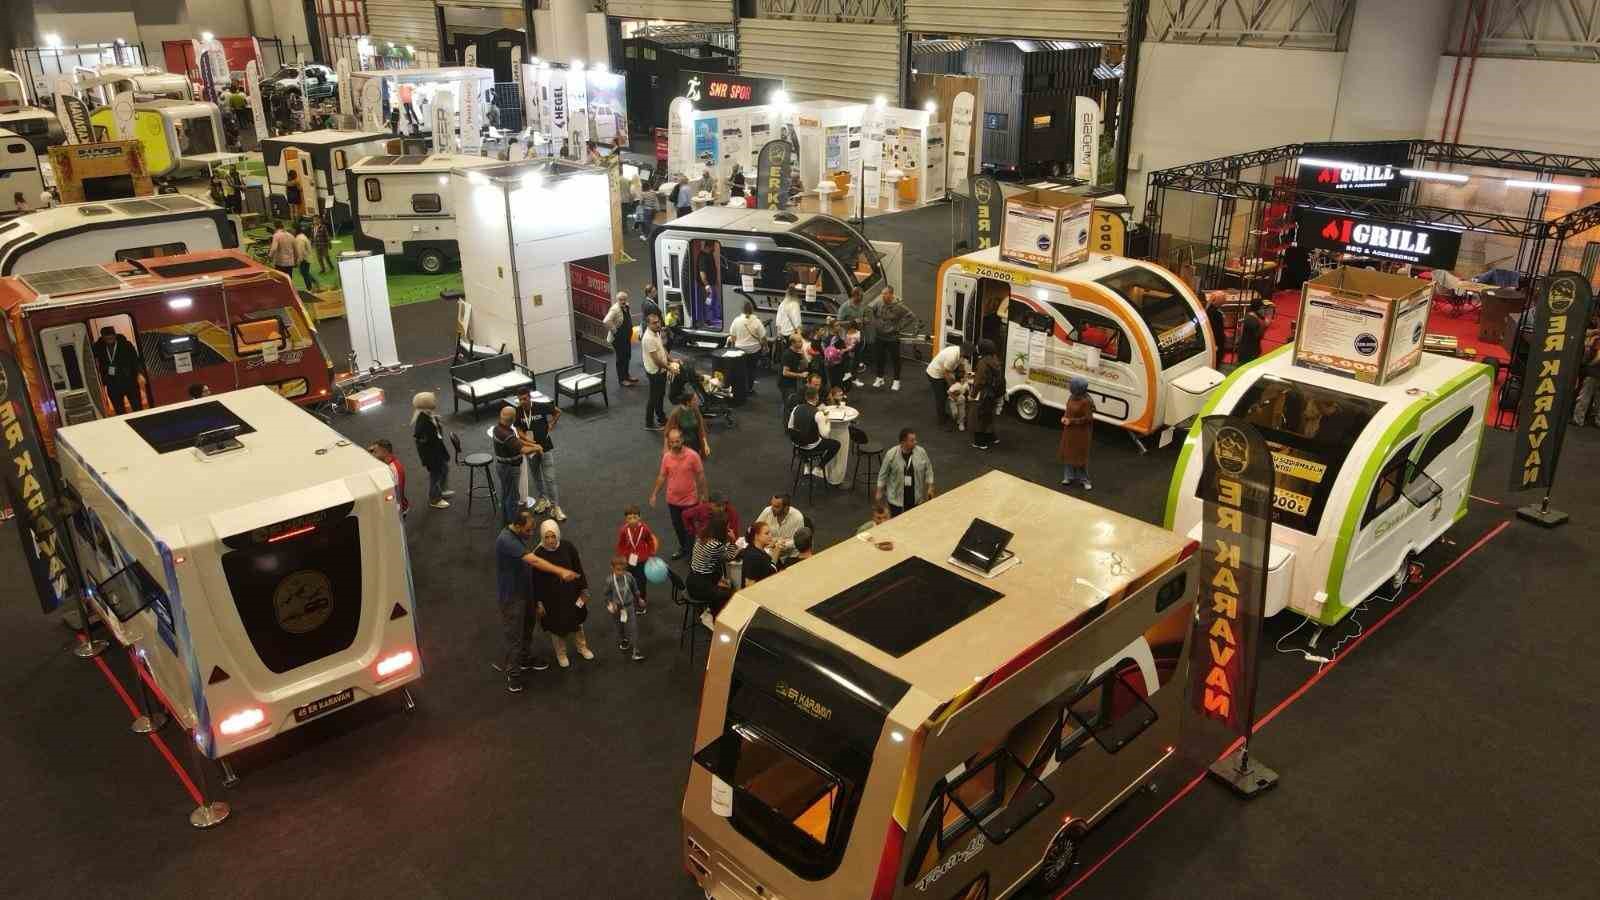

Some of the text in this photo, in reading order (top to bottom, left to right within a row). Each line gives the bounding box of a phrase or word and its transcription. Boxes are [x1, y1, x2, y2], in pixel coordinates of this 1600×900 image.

[709, 82, 752, 101] SNR SPOR
[554, 86, 564, 119] HEGEL
[769, 166, 782, 189] ER
[1346, 245, 1362, 253] BBQ
[1372, 249, 1419, 262] ACCESSORIES
